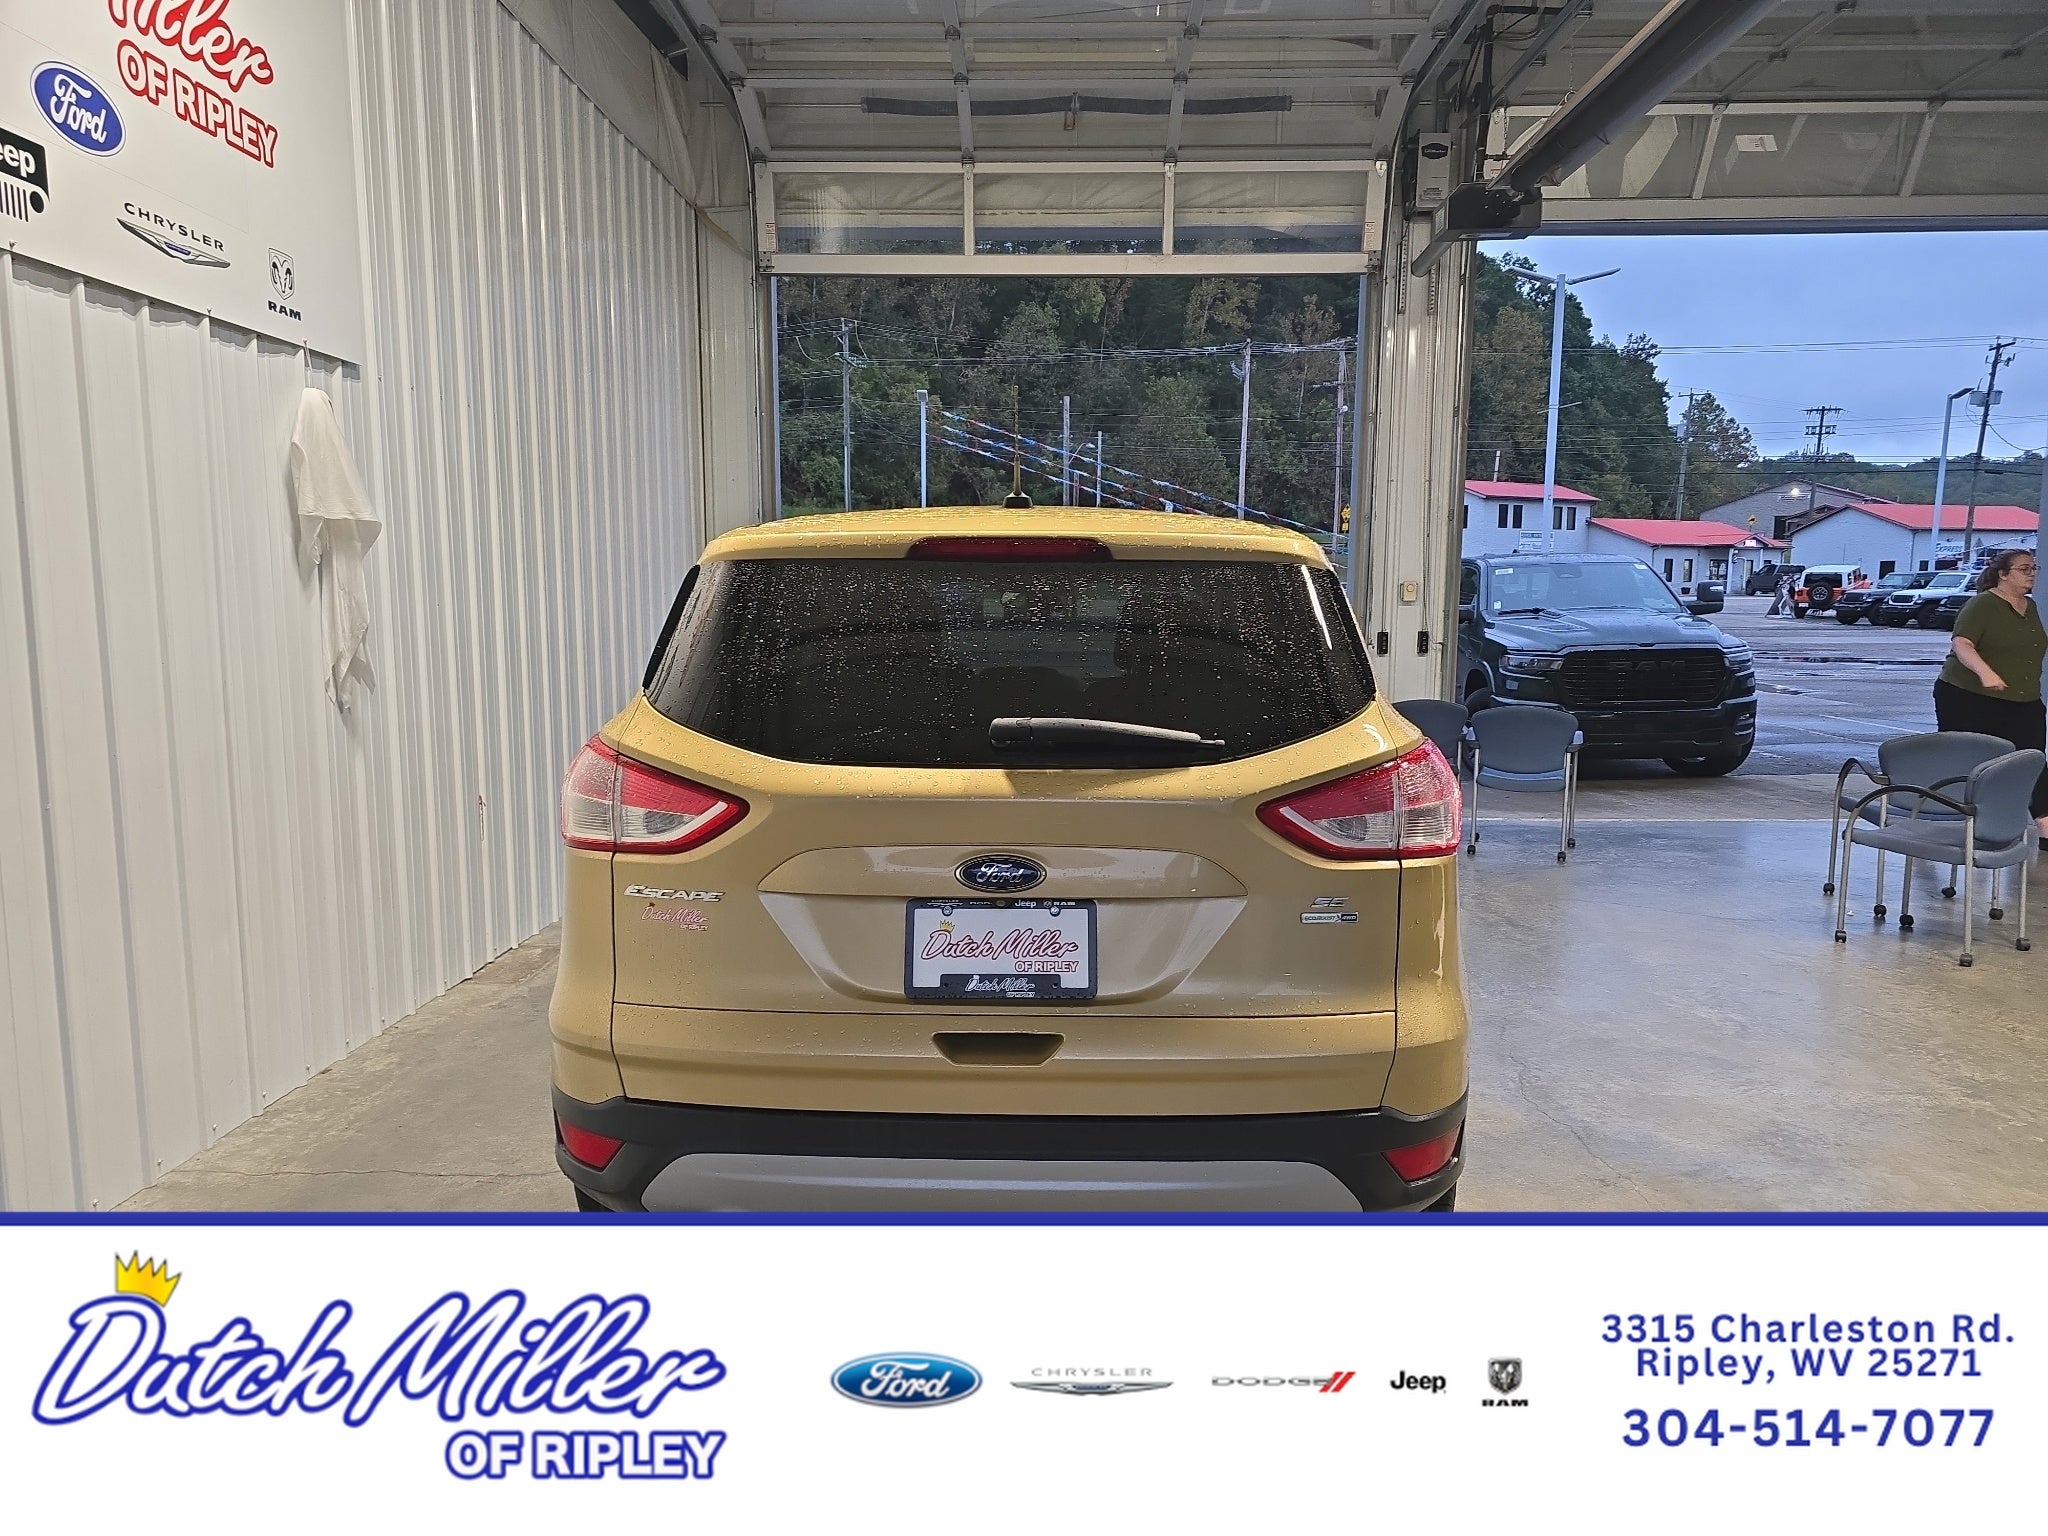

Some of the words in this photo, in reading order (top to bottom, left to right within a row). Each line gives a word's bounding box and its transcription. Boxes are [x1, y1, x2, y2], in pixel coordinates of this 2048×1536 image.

[50, 73, 108, 144] Ford
[117, 39, 168, 106] OF
[172, 67, 278, 168] RIPLEY
[123, 201, 225, 252] CHRYSLER
[267, 300, 302, 322] RAM
[976, 862, 1024, 883] Ford
[624, 884, 725, 902] ESCAPE
[1014, 899, 1037, 908] Jeep
[671, 907, 709, 923] Miller
[921, 929, 995, 960] Dutch
[992, 928, 1079, 960] Miller
[1014, 960, 1033, 973] OF
[1035, 960, 1079, 972] RIPLEY
